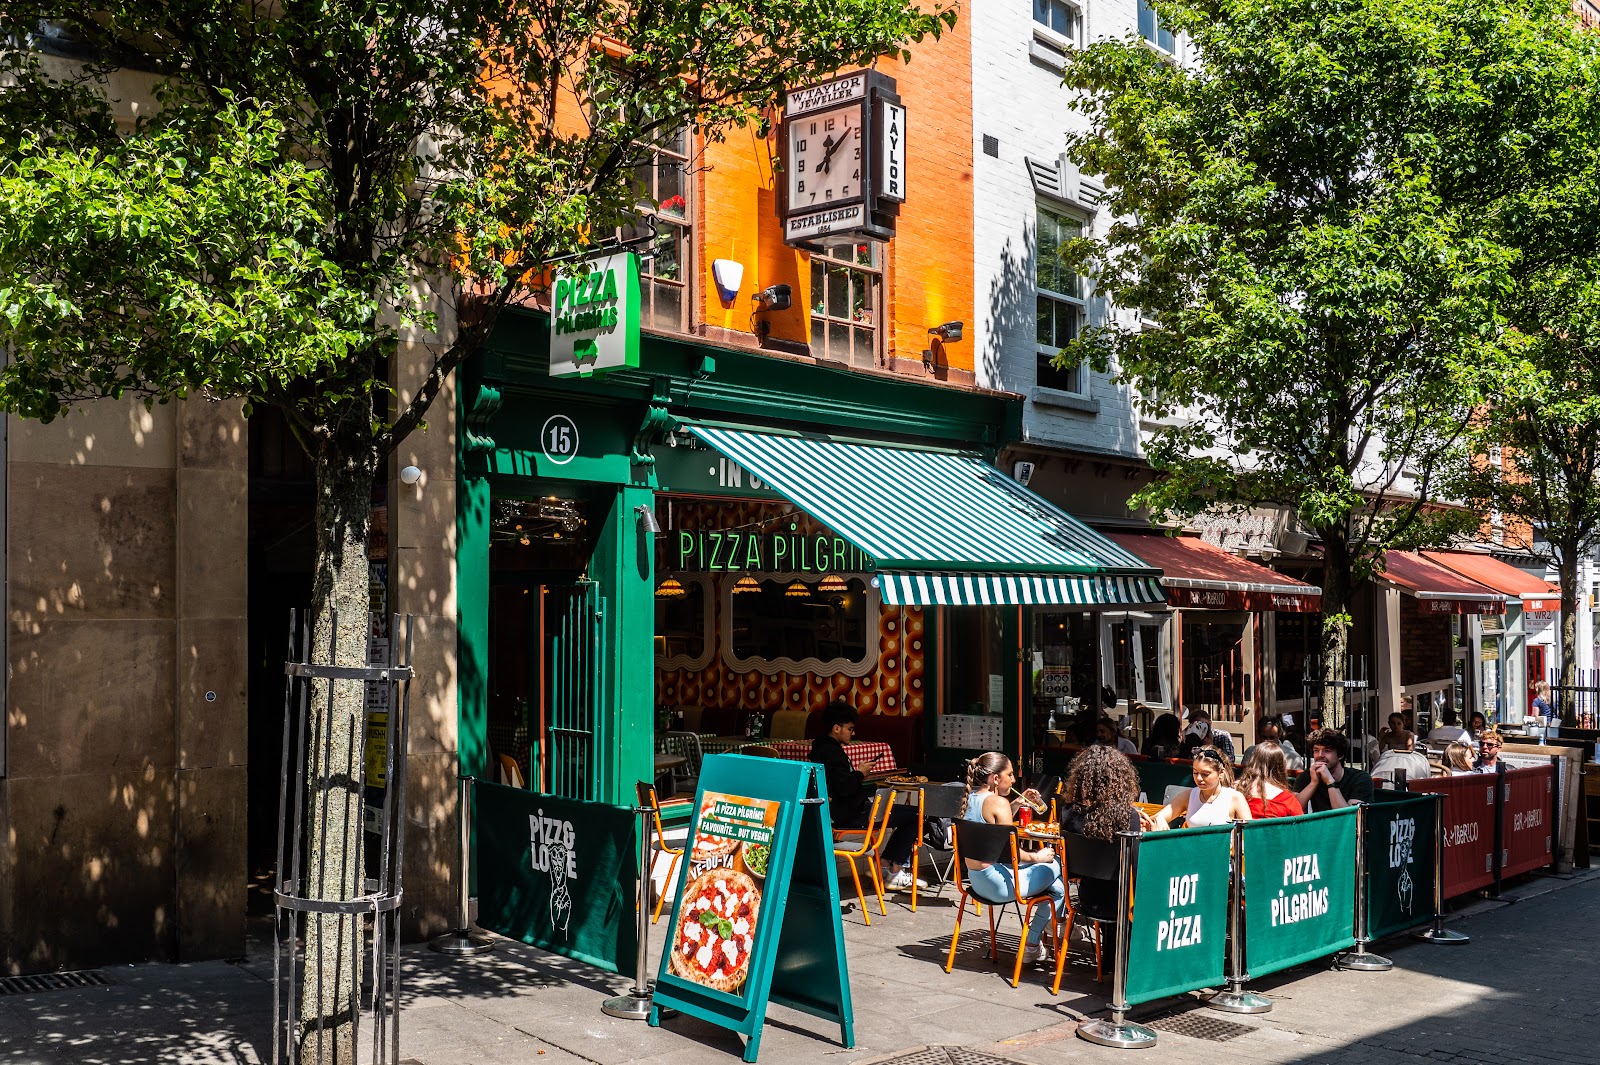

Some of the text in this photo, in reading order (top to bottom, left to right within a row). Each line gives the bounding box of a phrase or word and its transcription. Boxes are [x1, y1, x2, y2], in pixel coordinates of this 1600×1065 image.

[798, 89, 853, 110] JEWELLER
[810, 122, 817, 136] 11
[824, 118, 835, 132] 12
[796, 139, 807, 153] 10
[890, 107, 898, 194] TAYLOR
[798, 160, 805, 173] 9
[853, 169, 860, 181] 4
[798, 180, 805, 193] 8
[791, 207, 860, 231] ESTABLISHED
[555, 268, 618, 309] PIZZA
[555, 305, 618, 335] PILGRIMS
[549, 425, 570, 454] 15
[719, 457, 742, 488] IN
[680, 531, 761, 570] PIZZA
[715, 803, 764, 820] A PIZZA PILGRIMS
[738, 828, 750, 839] BUT
[750, 830, 769, 842] VEGAN
[690, 854, 734, 880] VE-DU-YA
[1282, 853, 1321, 887] PIZZA
[1168, 873, 1199, 908] HOT
[1271, 884, 1329, 927] PILGRIMS
[1156, 910, 1202, 952] PIZZA
